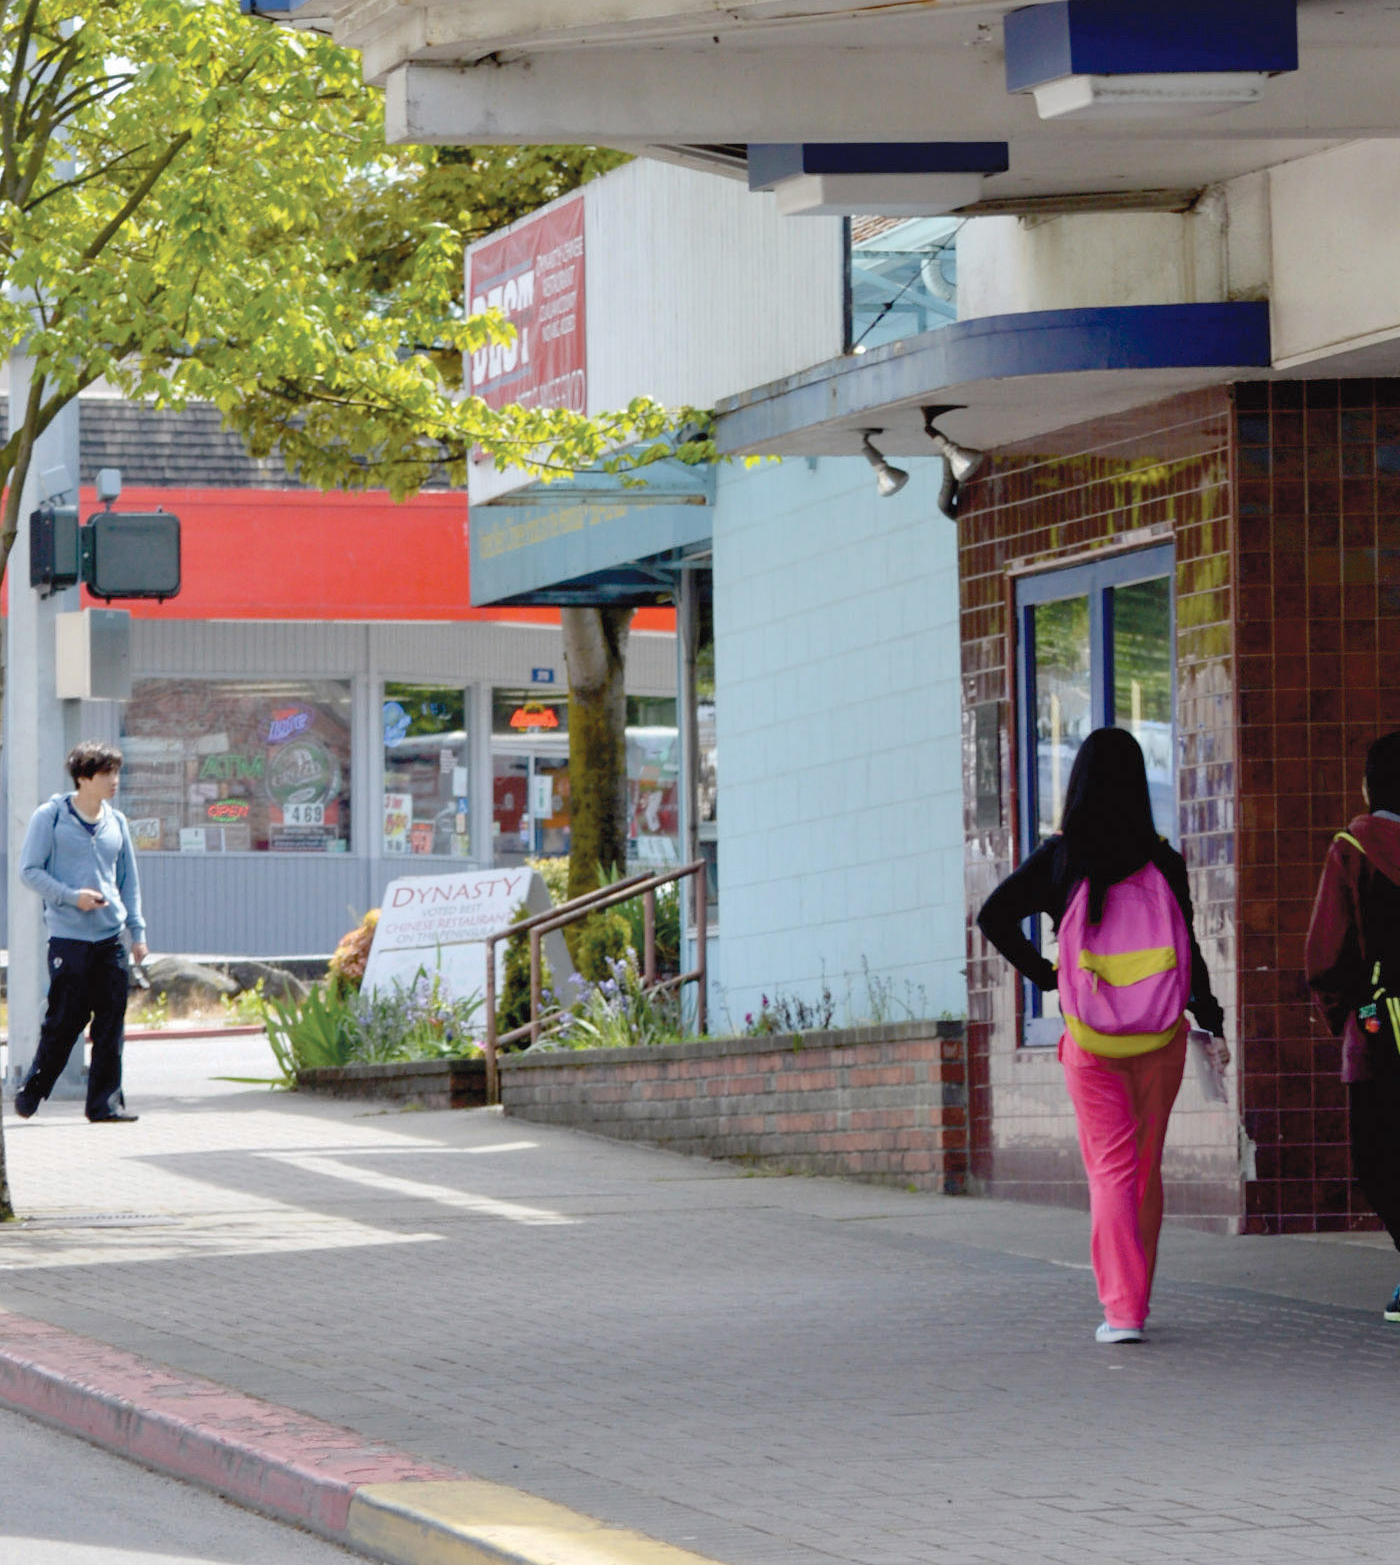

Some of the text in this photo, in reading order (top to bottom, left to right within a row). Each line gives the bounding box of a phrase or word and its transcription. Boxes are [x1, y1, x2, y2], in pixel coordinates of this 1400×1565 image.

[200, 754, 266, 780] ATM
[207, 803, 250, 818] OPEN
[392, 875, 522, 908] DYNASTY
[385, 912, 512, 935] CHINESE RESTAURANT
